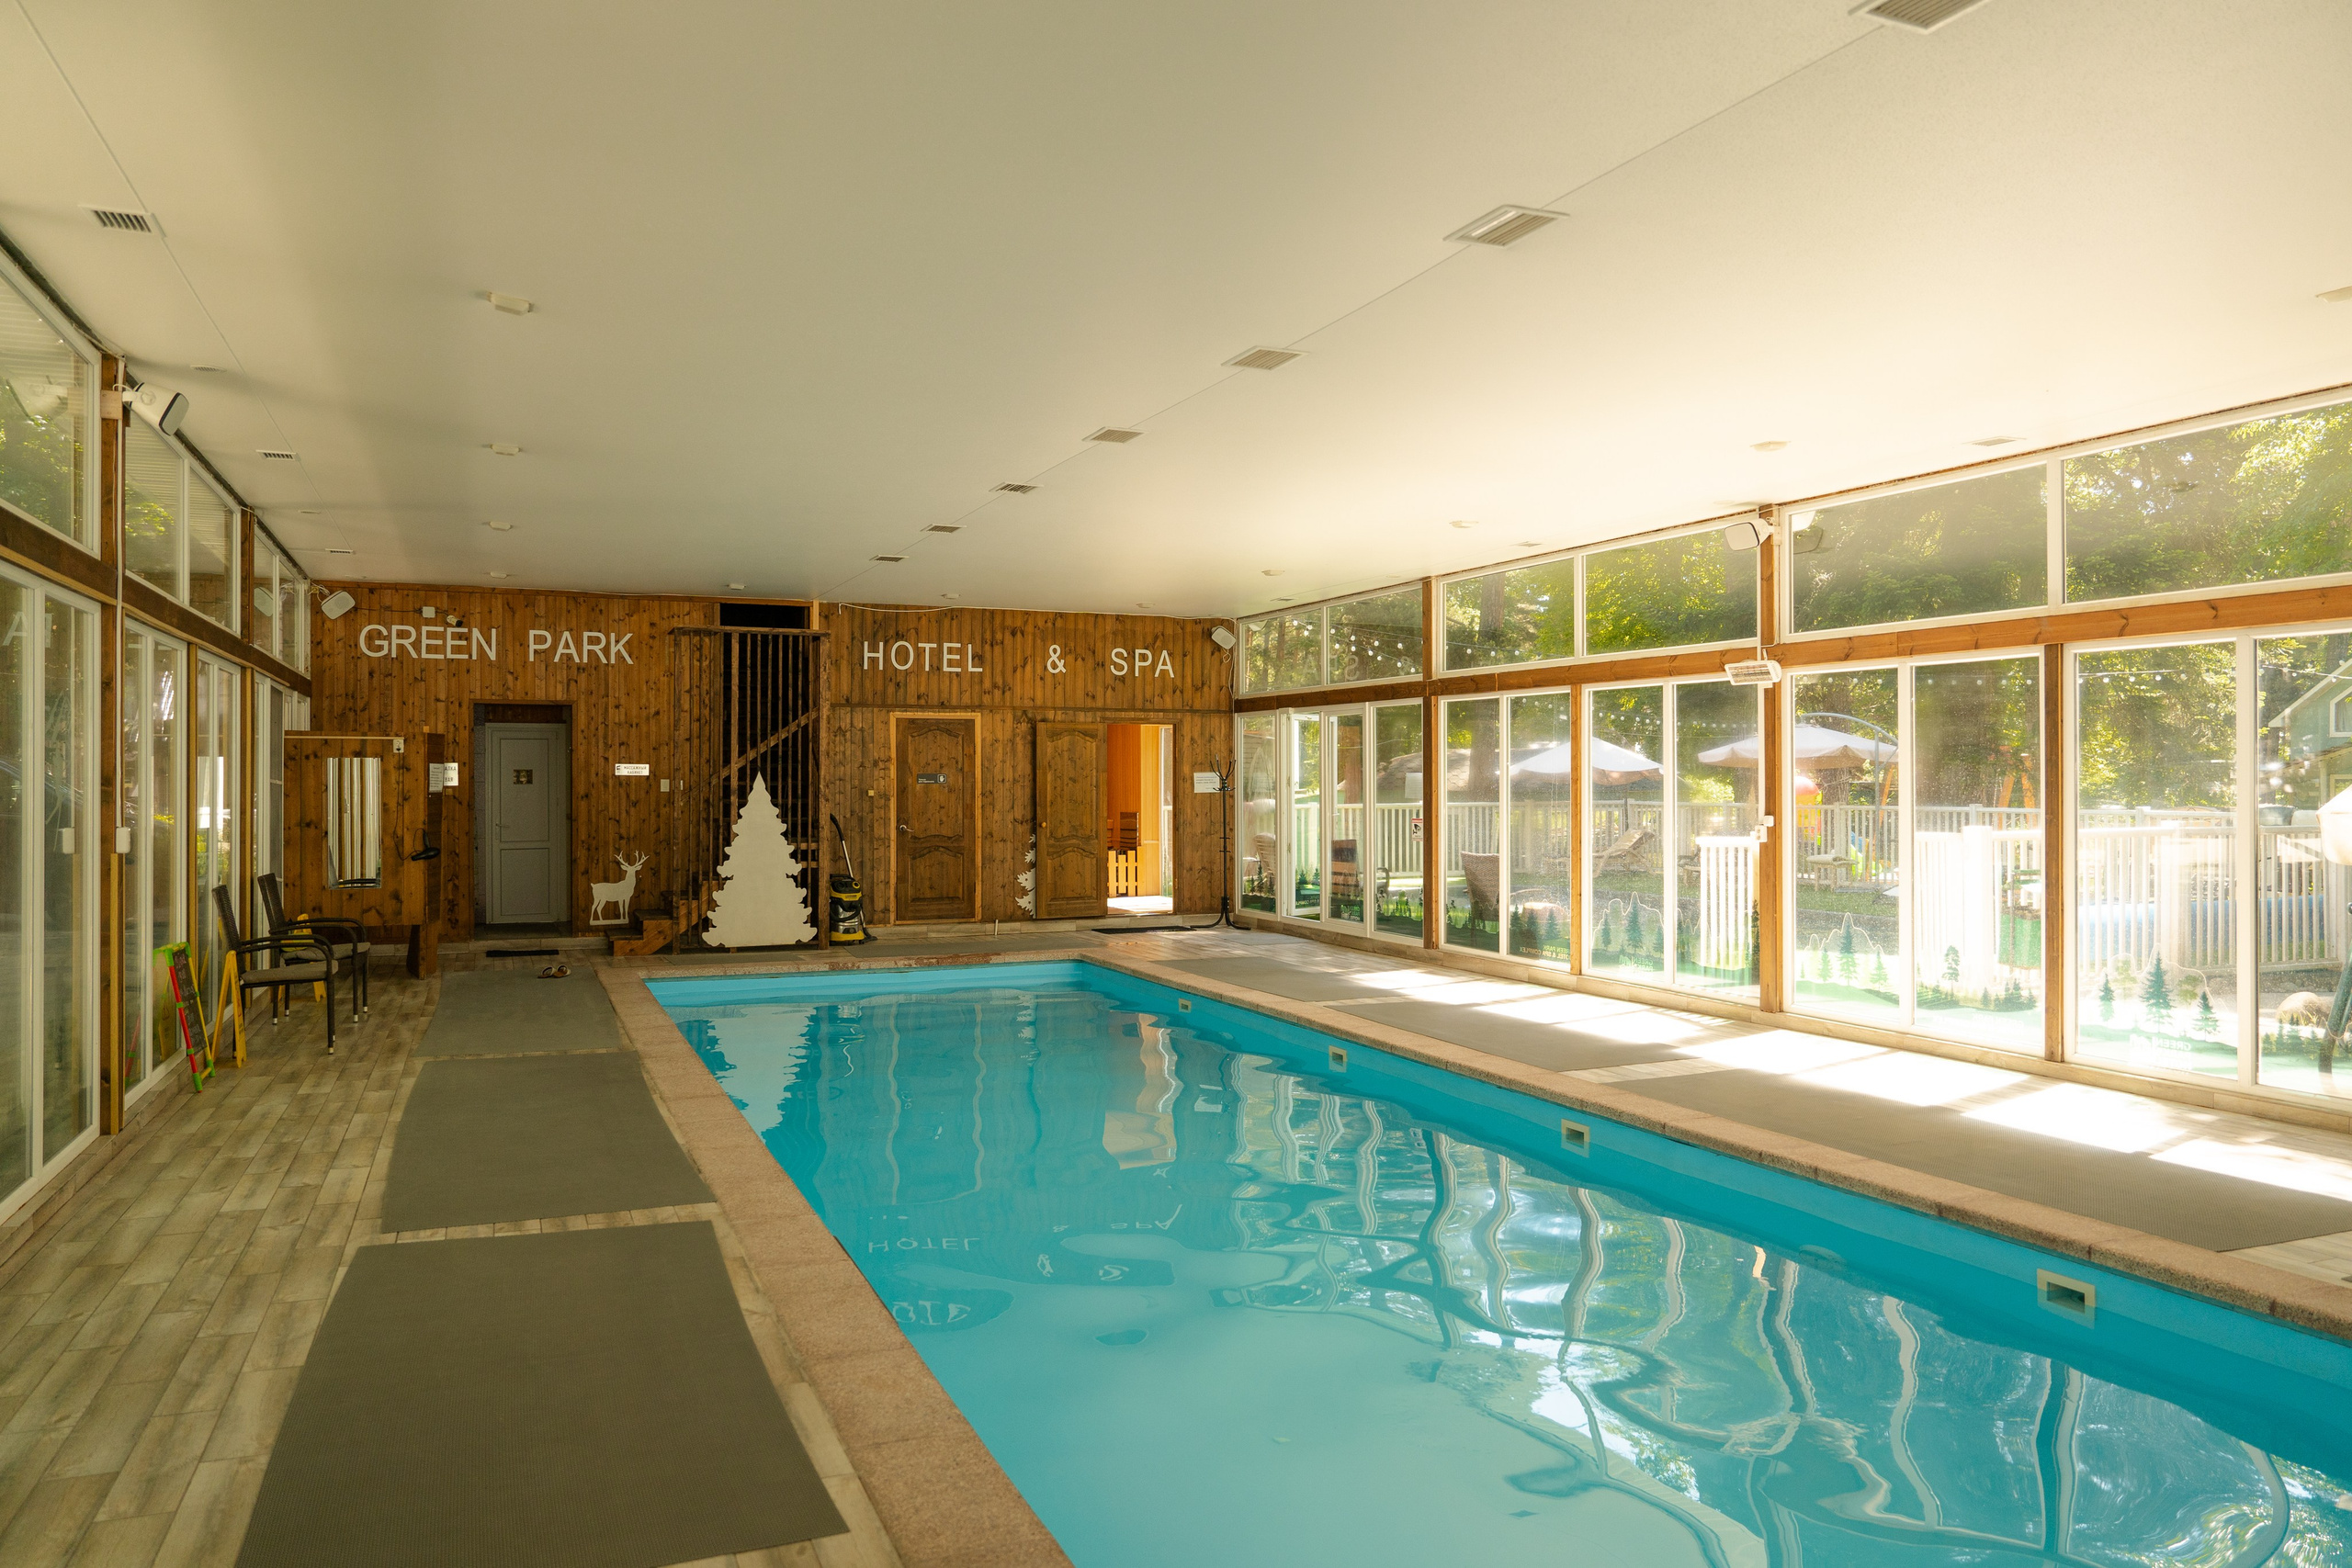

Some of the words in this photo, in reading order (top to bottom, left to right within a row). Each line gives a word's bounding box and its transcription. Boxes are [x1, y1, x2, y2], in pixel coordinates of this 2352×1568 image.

[358, 624, 497, 660] GREEN
[528, 629, 634, 665] PARK
[863, 640, 983, 672] HOTEL
[1046, 644, 1067, 674] &
[1110, 648, 1175, 678] SPA
